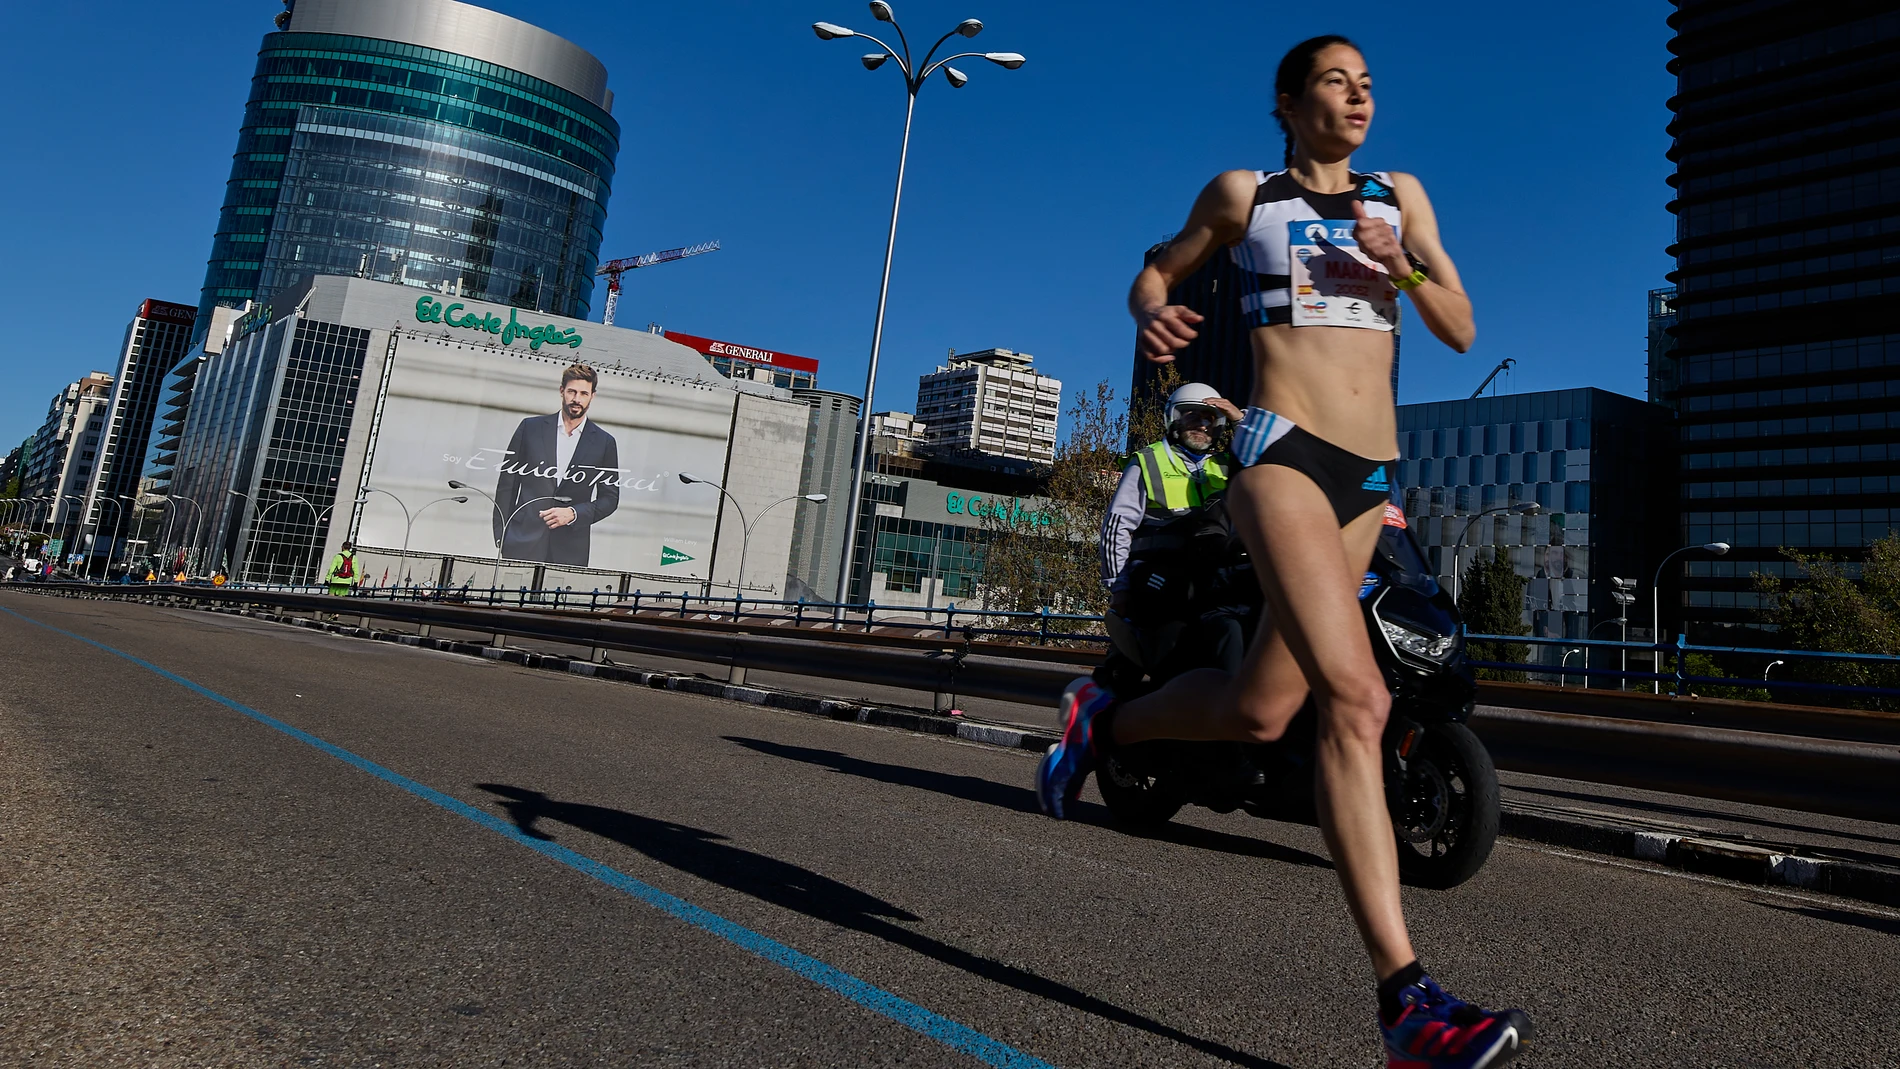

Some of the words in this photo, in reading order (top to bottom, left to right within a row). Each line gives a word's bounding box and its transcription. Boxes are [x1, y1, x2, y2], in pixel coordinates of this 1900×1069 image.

[169, 307, 197, 320] GEN
[416, 295, 442, 323] El
[444, 303, 502, 334] Corte
[501, 308, 583, 350] Inglés
[725, 344, 773, 363] GENERALI
[442, 453, 462, 465] Soy
[465, 447, 587, 483] Emidio
[578, 465, 660, 492] Tucci
[946, 491, 965, 514] El
[1010, 497, 1065, 531] Ingl
